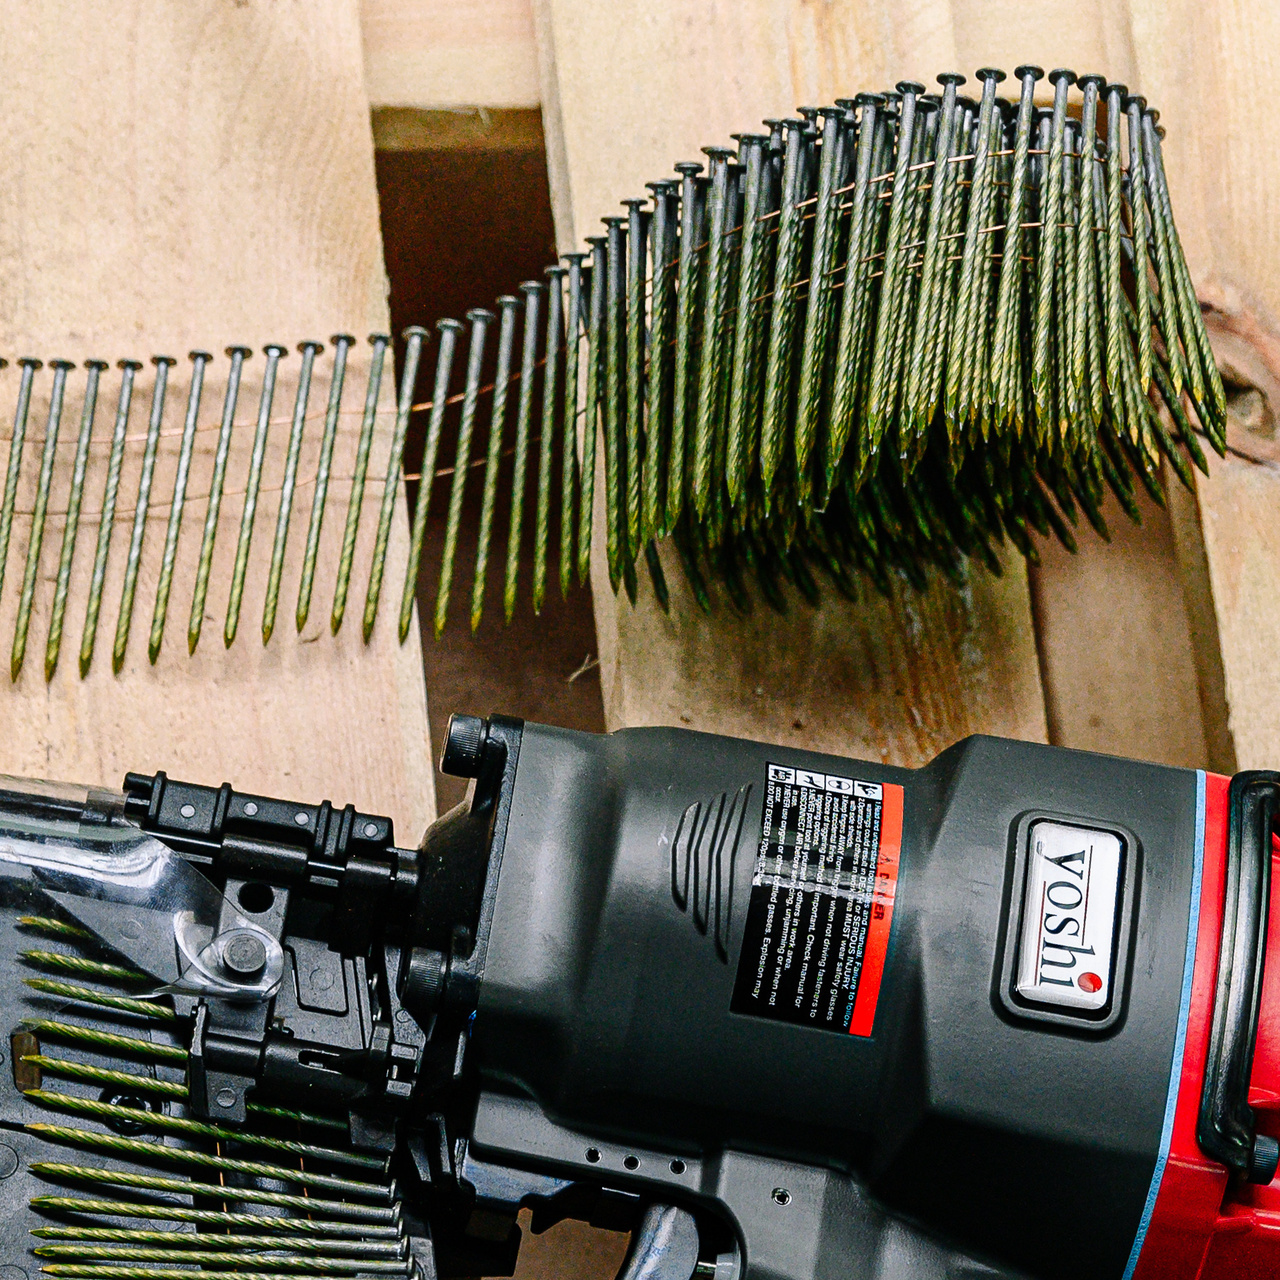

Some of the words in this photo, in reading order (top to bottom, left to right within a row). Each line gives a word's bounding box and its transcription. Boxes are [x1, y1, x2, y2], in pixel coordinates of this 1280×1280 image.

[766, 794, 774, 808] NOT
[813, 794, 824, 820] triggering
[763, 808, 773, 836] EXCEED
[778, 820, 787, 845] oxygen
[804, 812, 813, 829] point
[829, 812, 838, 844] accidental
[838, 813, 848, 834] fingers
[795, 831, 803, 845] AIR
[804, 829, 812, 843] tool
[812, 820, 822, 847] options.
[818, 822, 829, 854] triggering
[837, 834, 846, 855] AWAY
[777, 845, 784, 854] or
[792, 845, 801, 869] before
[803, 842, 810, 850] at
[826, 844, 836, 863] firing.
[852, 843, 861, 865] others
[869, 831, 878, 869] understand
[774, 854, 783, 874] other
[797, 850, 810, 880] yourself
[815, 854, 827, 883] method
[834, 855, 843, 873] from
[860, 867, 866, 875] in
[769, 874, 780, 903] bottled
[797, 880, 804, 890] or
[829, 873, 841, 898] trigger
[848, 874, 858, 893] work
[866, 869, 875, 885] tool
[855, 875, 866, 904] DEATH
[793, 889, 804, 917] others
[806, 891, 821, 932] important.
[827, 900, 836, 922] when
[855, 904, 861, 914] or
[764, 903, 775, 934] gasses.
[792, 918, 800, 926] in
[842, 913, 852, 939] MUST
[1036, 841, 1102, 993] yoshi
[776, 908, 791, 954] unjamming
[788, 927, 797, 948] work
[847, 915, 861, 954] SERIOUS
[855, 927, 866, 958] manual.
[757, 937, 771, 978] Explosion
[784, 949, 793, 970] area.
[803, 934, 814, 961] Check
[817, 938, 830, 967] driving
[838, 940, 846, 960] wear
[777, 955, 783, 965] or
[772, 966, 781, 989] when
[797, 962, 808, 994] manual
[831, 961, 843, 987] safety
[841, 956, 854, 989] INJURY.
[849, 961, 862, 990] Failure
[751, 980, 761, 998] may
[768, 991, 776, 1005] not
[811, 968, 825, 1007] fasteners
[848, 991, 855, 1000] to
[794, 995, 803, 1008] for
[809, 1009, 817, 1018] to
[826, 988, 838, 1020] glasses
[843, 1002, 853, 1027] follow
